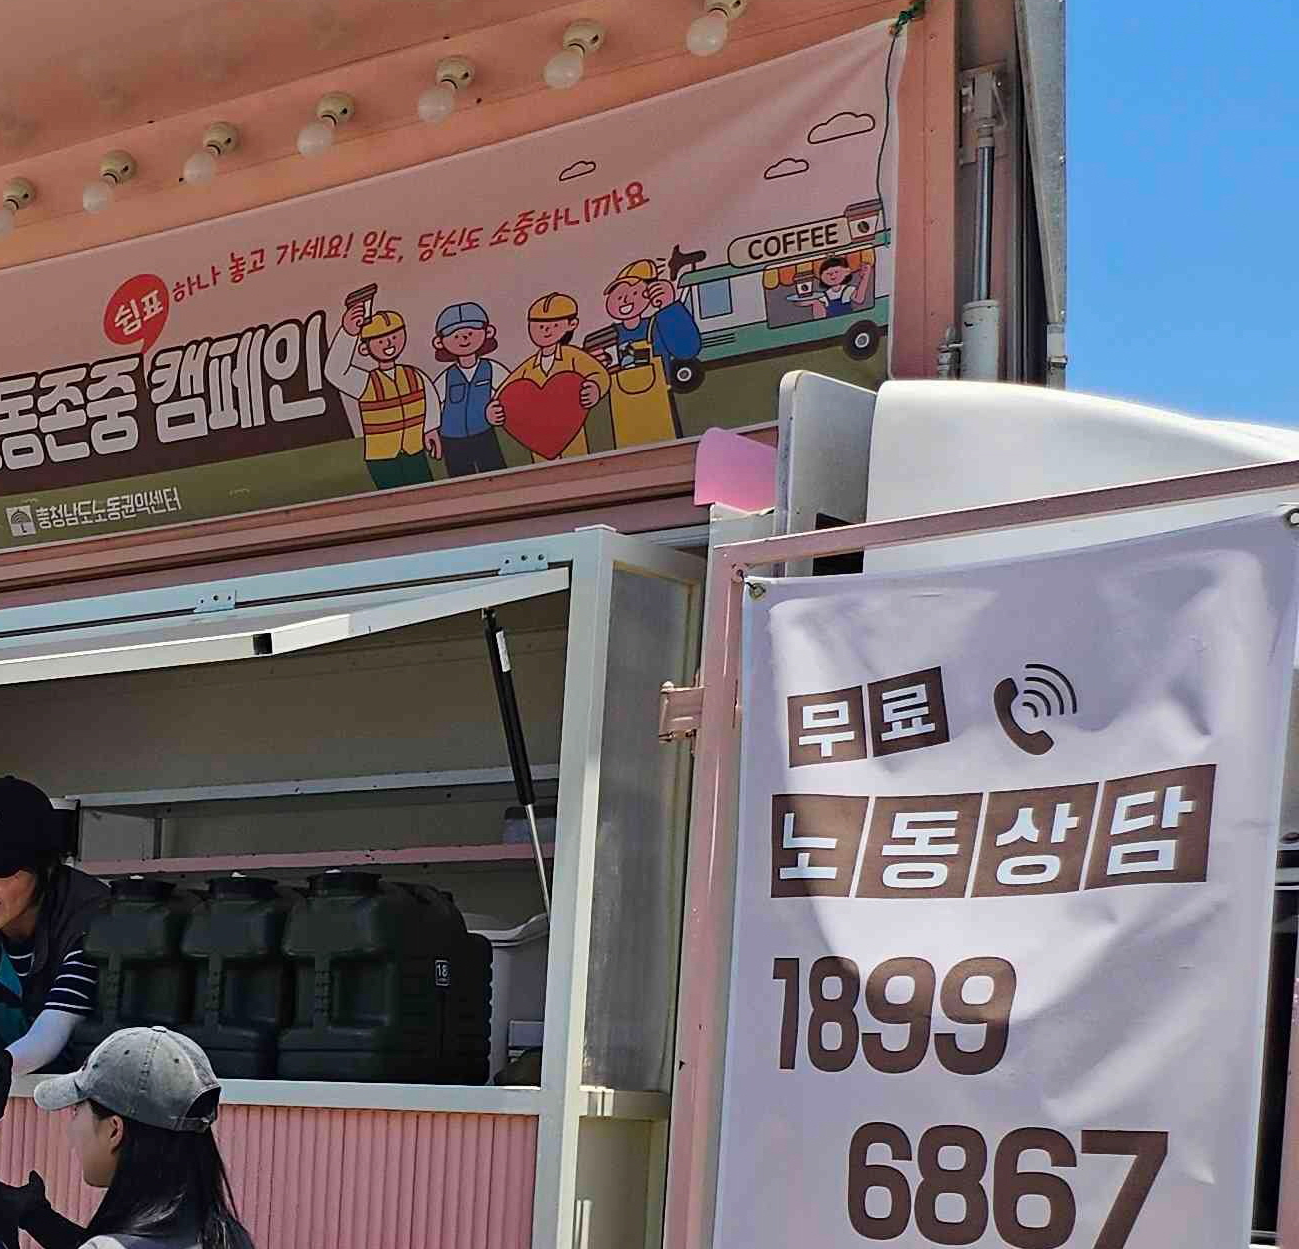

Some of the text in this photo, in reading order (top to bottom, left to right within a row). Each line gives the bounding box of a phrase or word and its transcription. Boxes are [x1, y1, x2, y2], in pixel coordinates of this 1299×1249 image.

[114, 181, 650, 336] 쉼표 하나 놓고 가세요! 일도, 당신도 소중하니까요
[748, 223, 839, 261] COFFEE
[150, 313, 327, 444] 캠페인
[35, 486, 182, 530] 충청남도노동권익센터
[796, 684, 939, 757] 무료
[776, 781, 1196, 891] 노동상담
[771, 955, 1017, 1076] 1899
